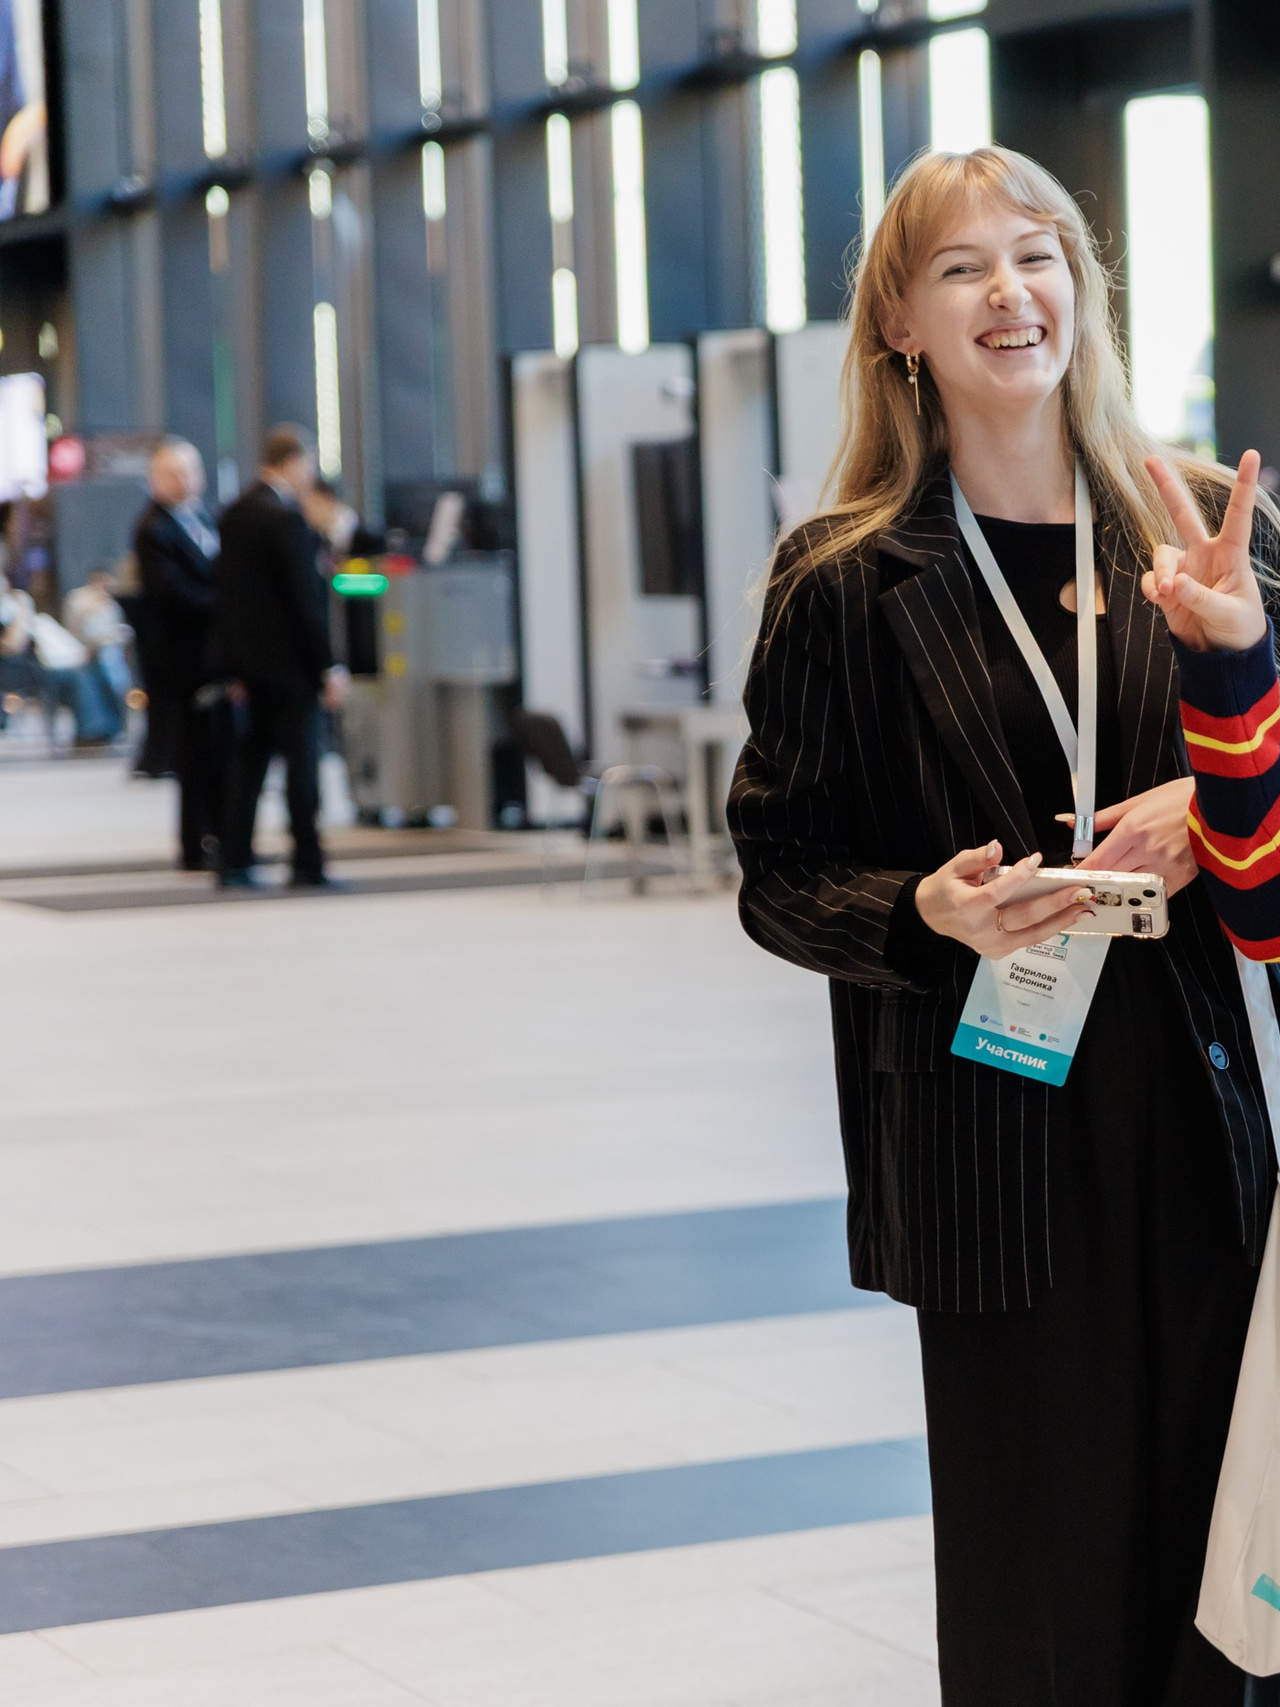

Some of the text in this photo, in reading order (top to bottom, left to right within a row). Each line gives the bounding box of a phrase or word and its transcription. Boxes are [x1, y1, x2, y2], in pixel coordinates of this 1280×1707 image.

[1009, 971, 1052, 991] Вероника
[1010, 962, 1057, 983] Гаврилова
[975, 1036, 1048, 1071] Участник
